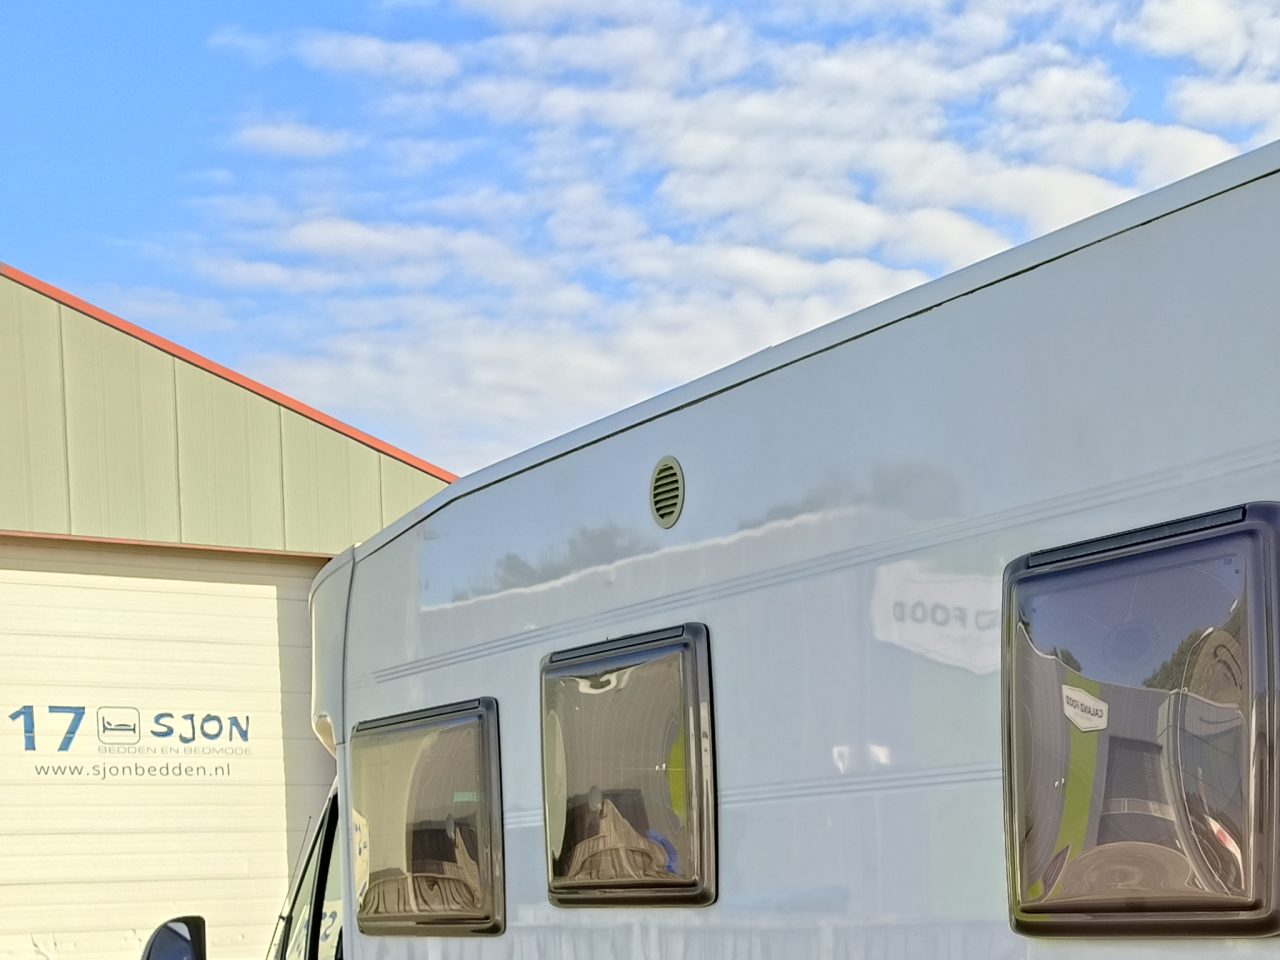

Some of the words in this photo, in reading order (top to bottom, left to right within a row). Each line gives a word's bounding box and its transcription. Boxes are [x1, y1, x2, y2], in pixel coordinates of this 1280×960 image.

[8, 704, 86, 752] 17
[150, 712, 250, 744] SJON
[98, 745, 157, 755] BEDDEN
[160, 746, 180, 755] EN
[183, 746, 253, 756] BEDMODE
[34, 762, 231, 780] www.sjonbedden.nl
